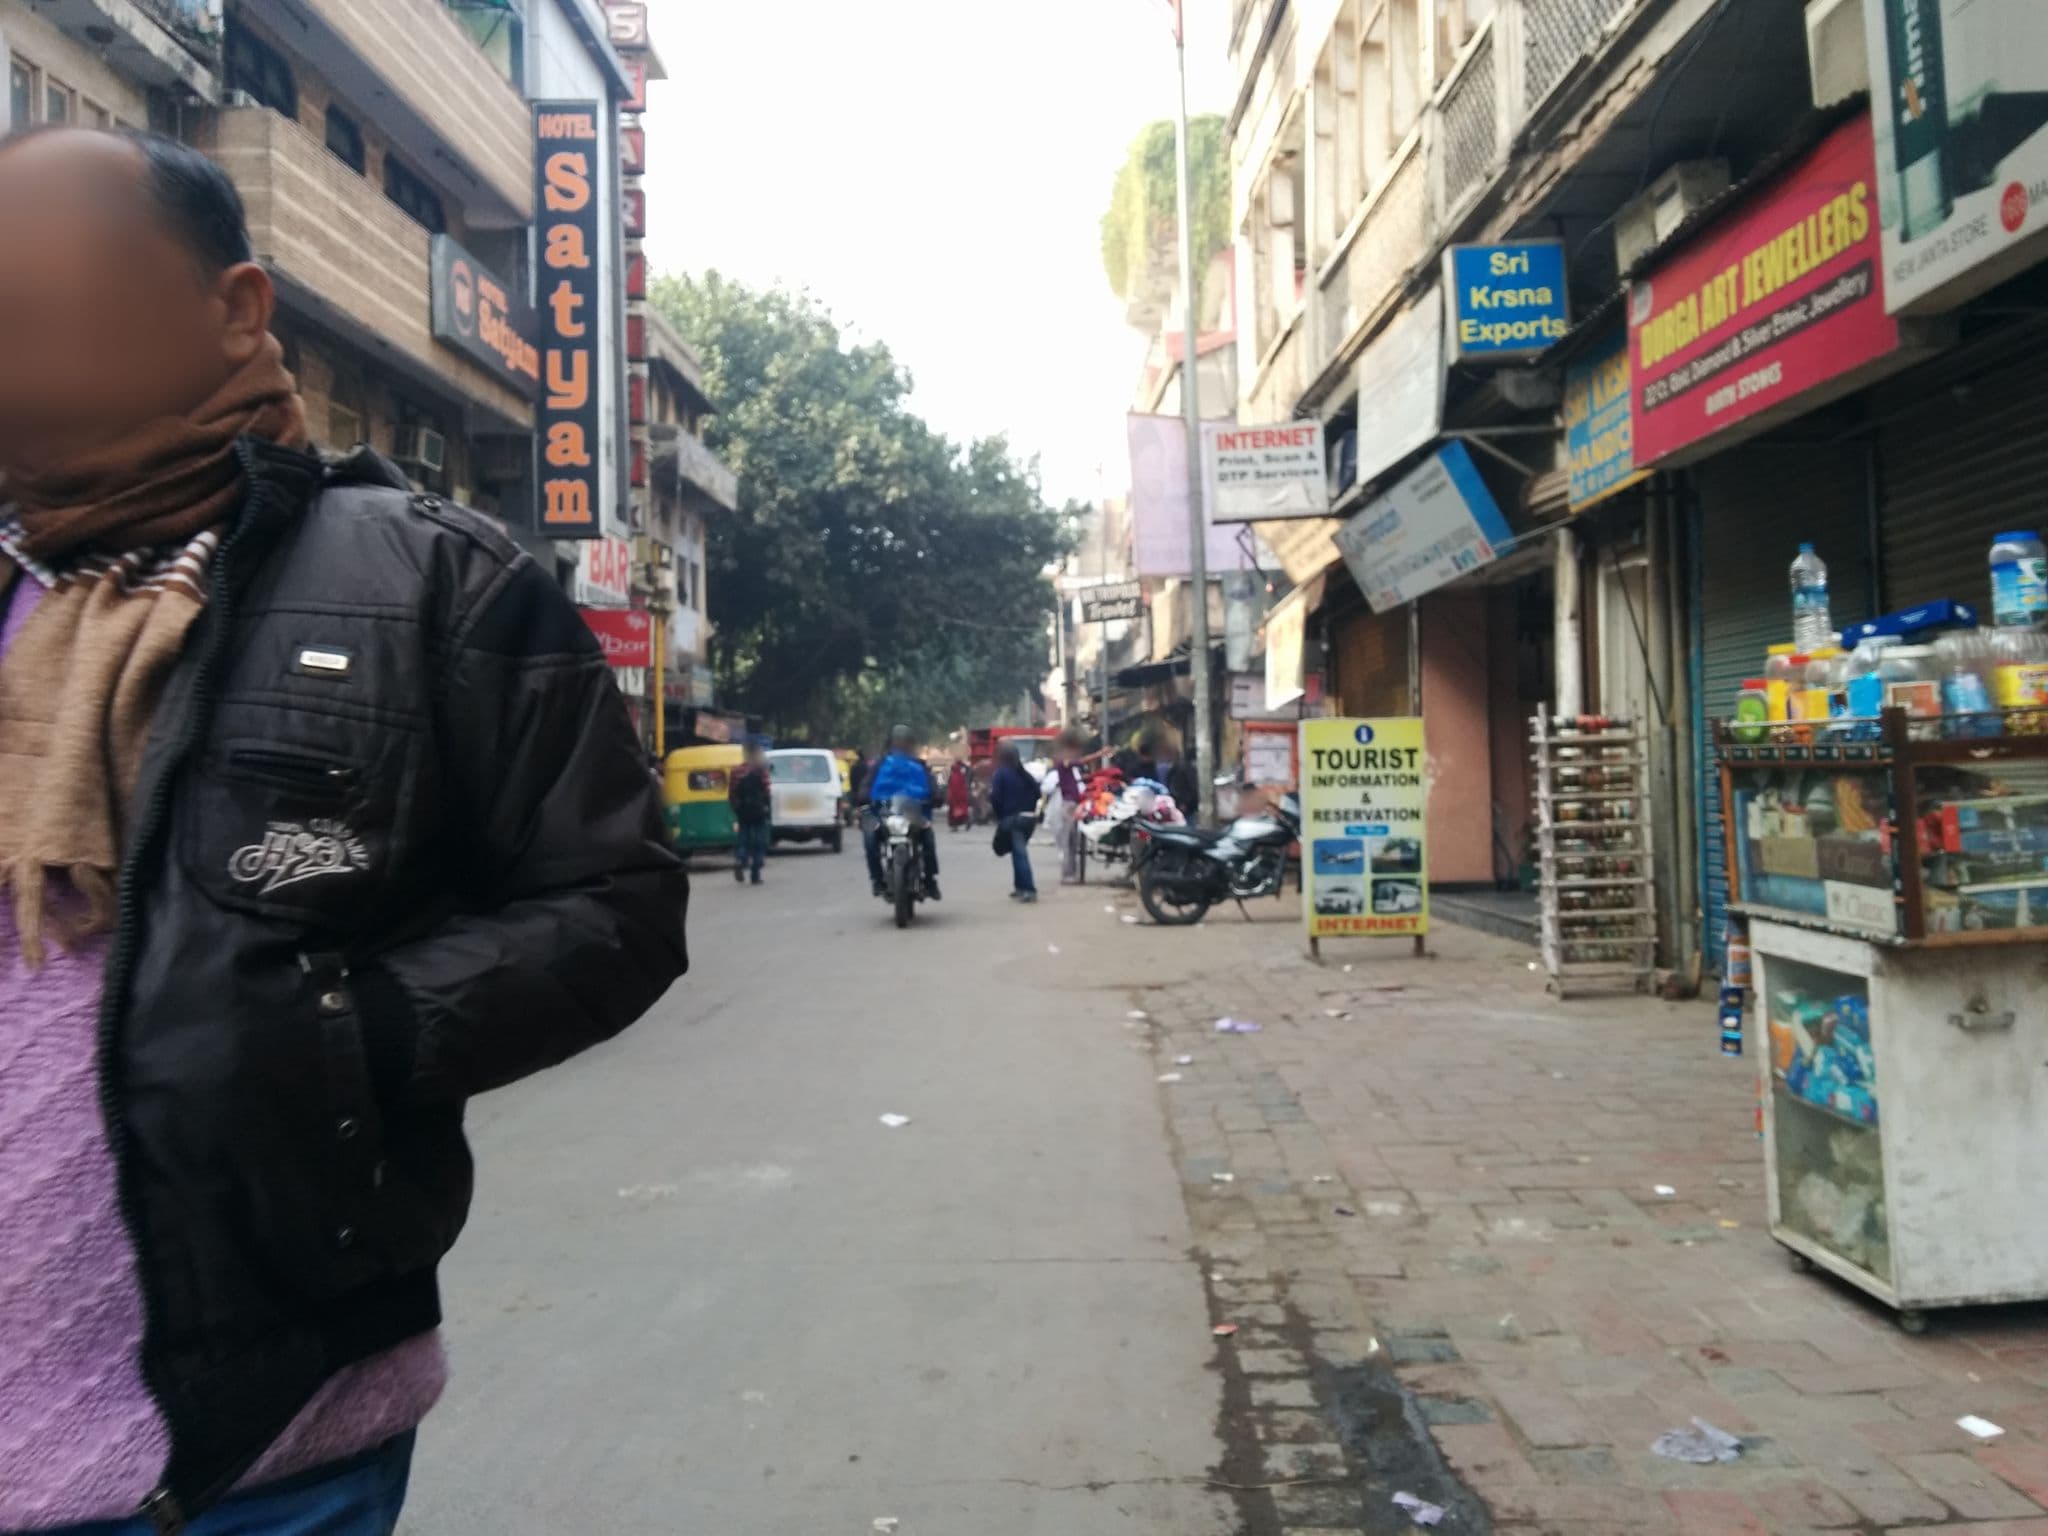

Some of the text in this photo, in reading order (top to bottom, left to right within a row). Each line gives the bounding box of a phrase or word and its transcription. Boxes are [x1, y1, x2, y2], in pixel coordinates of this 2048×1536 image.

[538, 114, 596, 138] HOTEL
[1489, 250, 1529, 276] Sri
[1640, 181, 1869, 369] DURGA ART JEWELLERS
[1470, 285, 1552, 309] Krsna
[544, 152, 592, 524] Satyam
[1460, 314, 1568, 345] Exports
[1216, 426, 1317, 452] INTERNET
[1264, 453, 1300, 464] Scan
[1307, 451, 1317, 460] &
[1218, 468, 1319, 482] DTP Services
[589, 537, 628, 592] BAR
[1312, 748, 1419, 769] TOURIST
[1312, 774, 1420, 787] INFORMATION
[1360, 792, 1371, 804] &
[1313, 808, 1420, 823] RESERVATION
[1317, 916, 1420, 932] INTERNET
